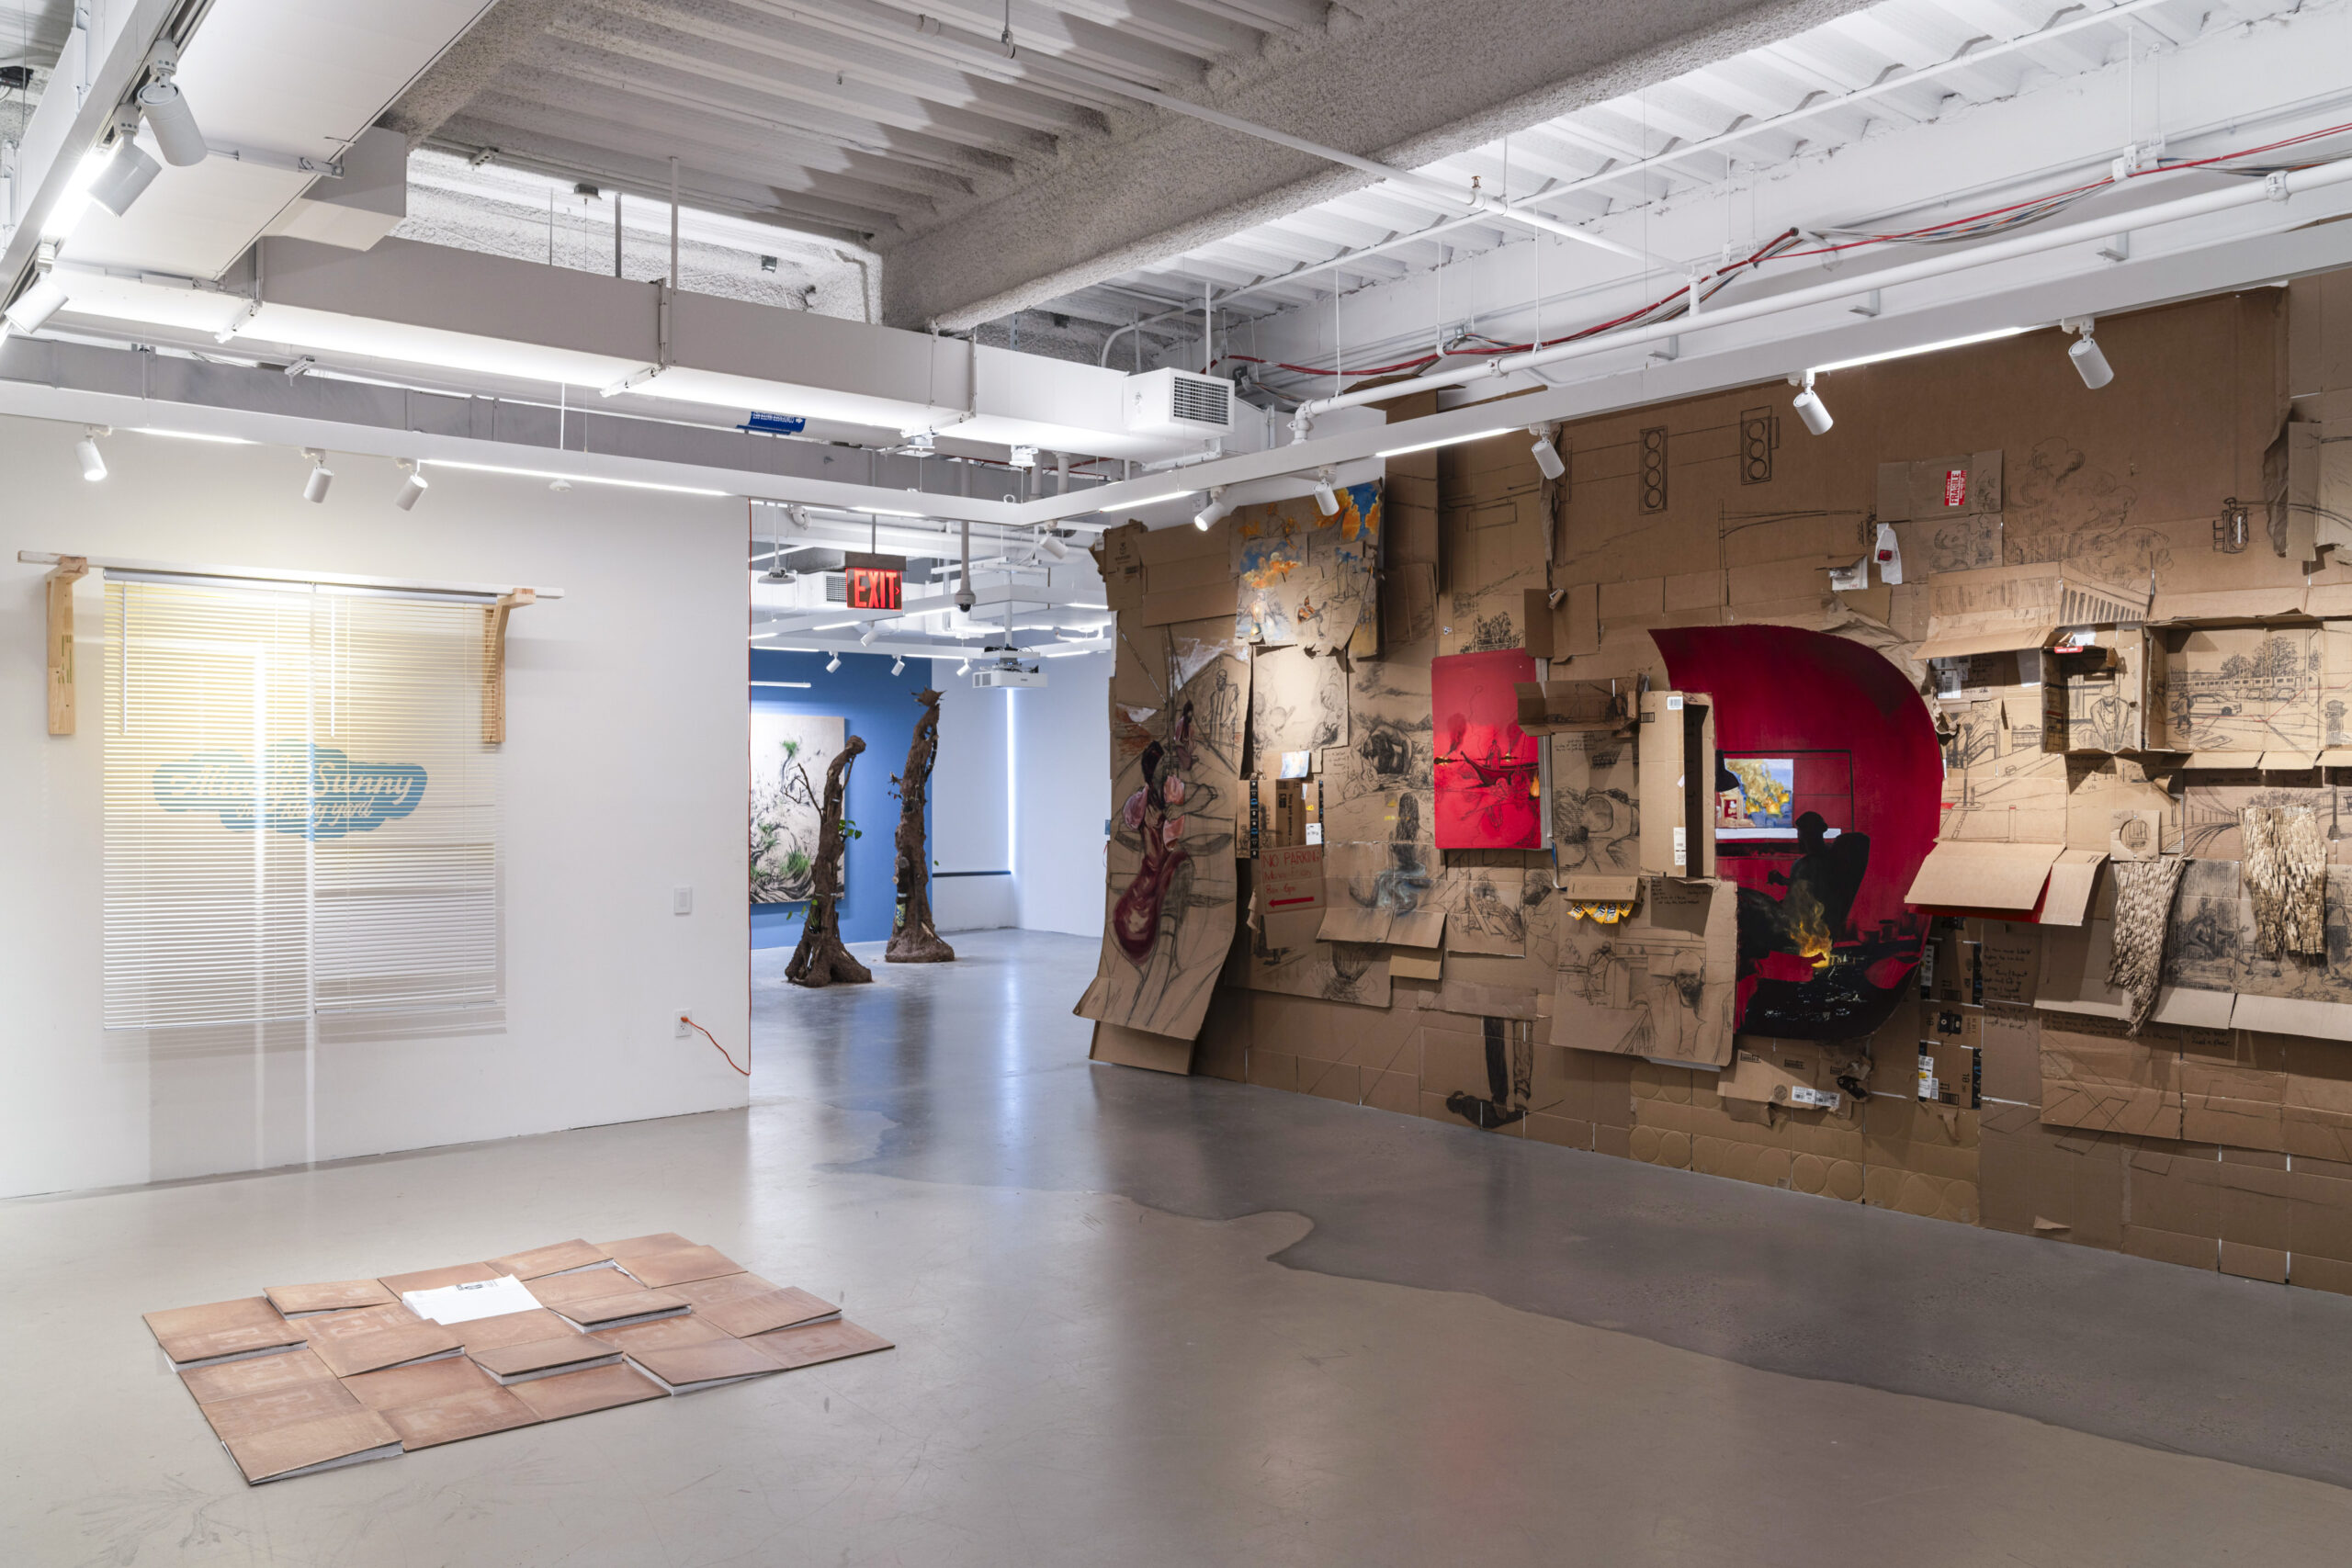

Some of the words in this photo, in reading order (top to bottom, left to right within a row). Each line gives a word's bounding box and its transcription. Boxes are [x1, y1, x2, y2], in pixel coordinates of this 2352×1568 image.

[1951, 473, 1960, 503] FRAGILE
[854, 570, 897, 609] EXIT
[315, 761, 413, 805] Sunny
[1263, 854, 1279, 867] NO
[1283, 848, 1320, 865] PARKING
